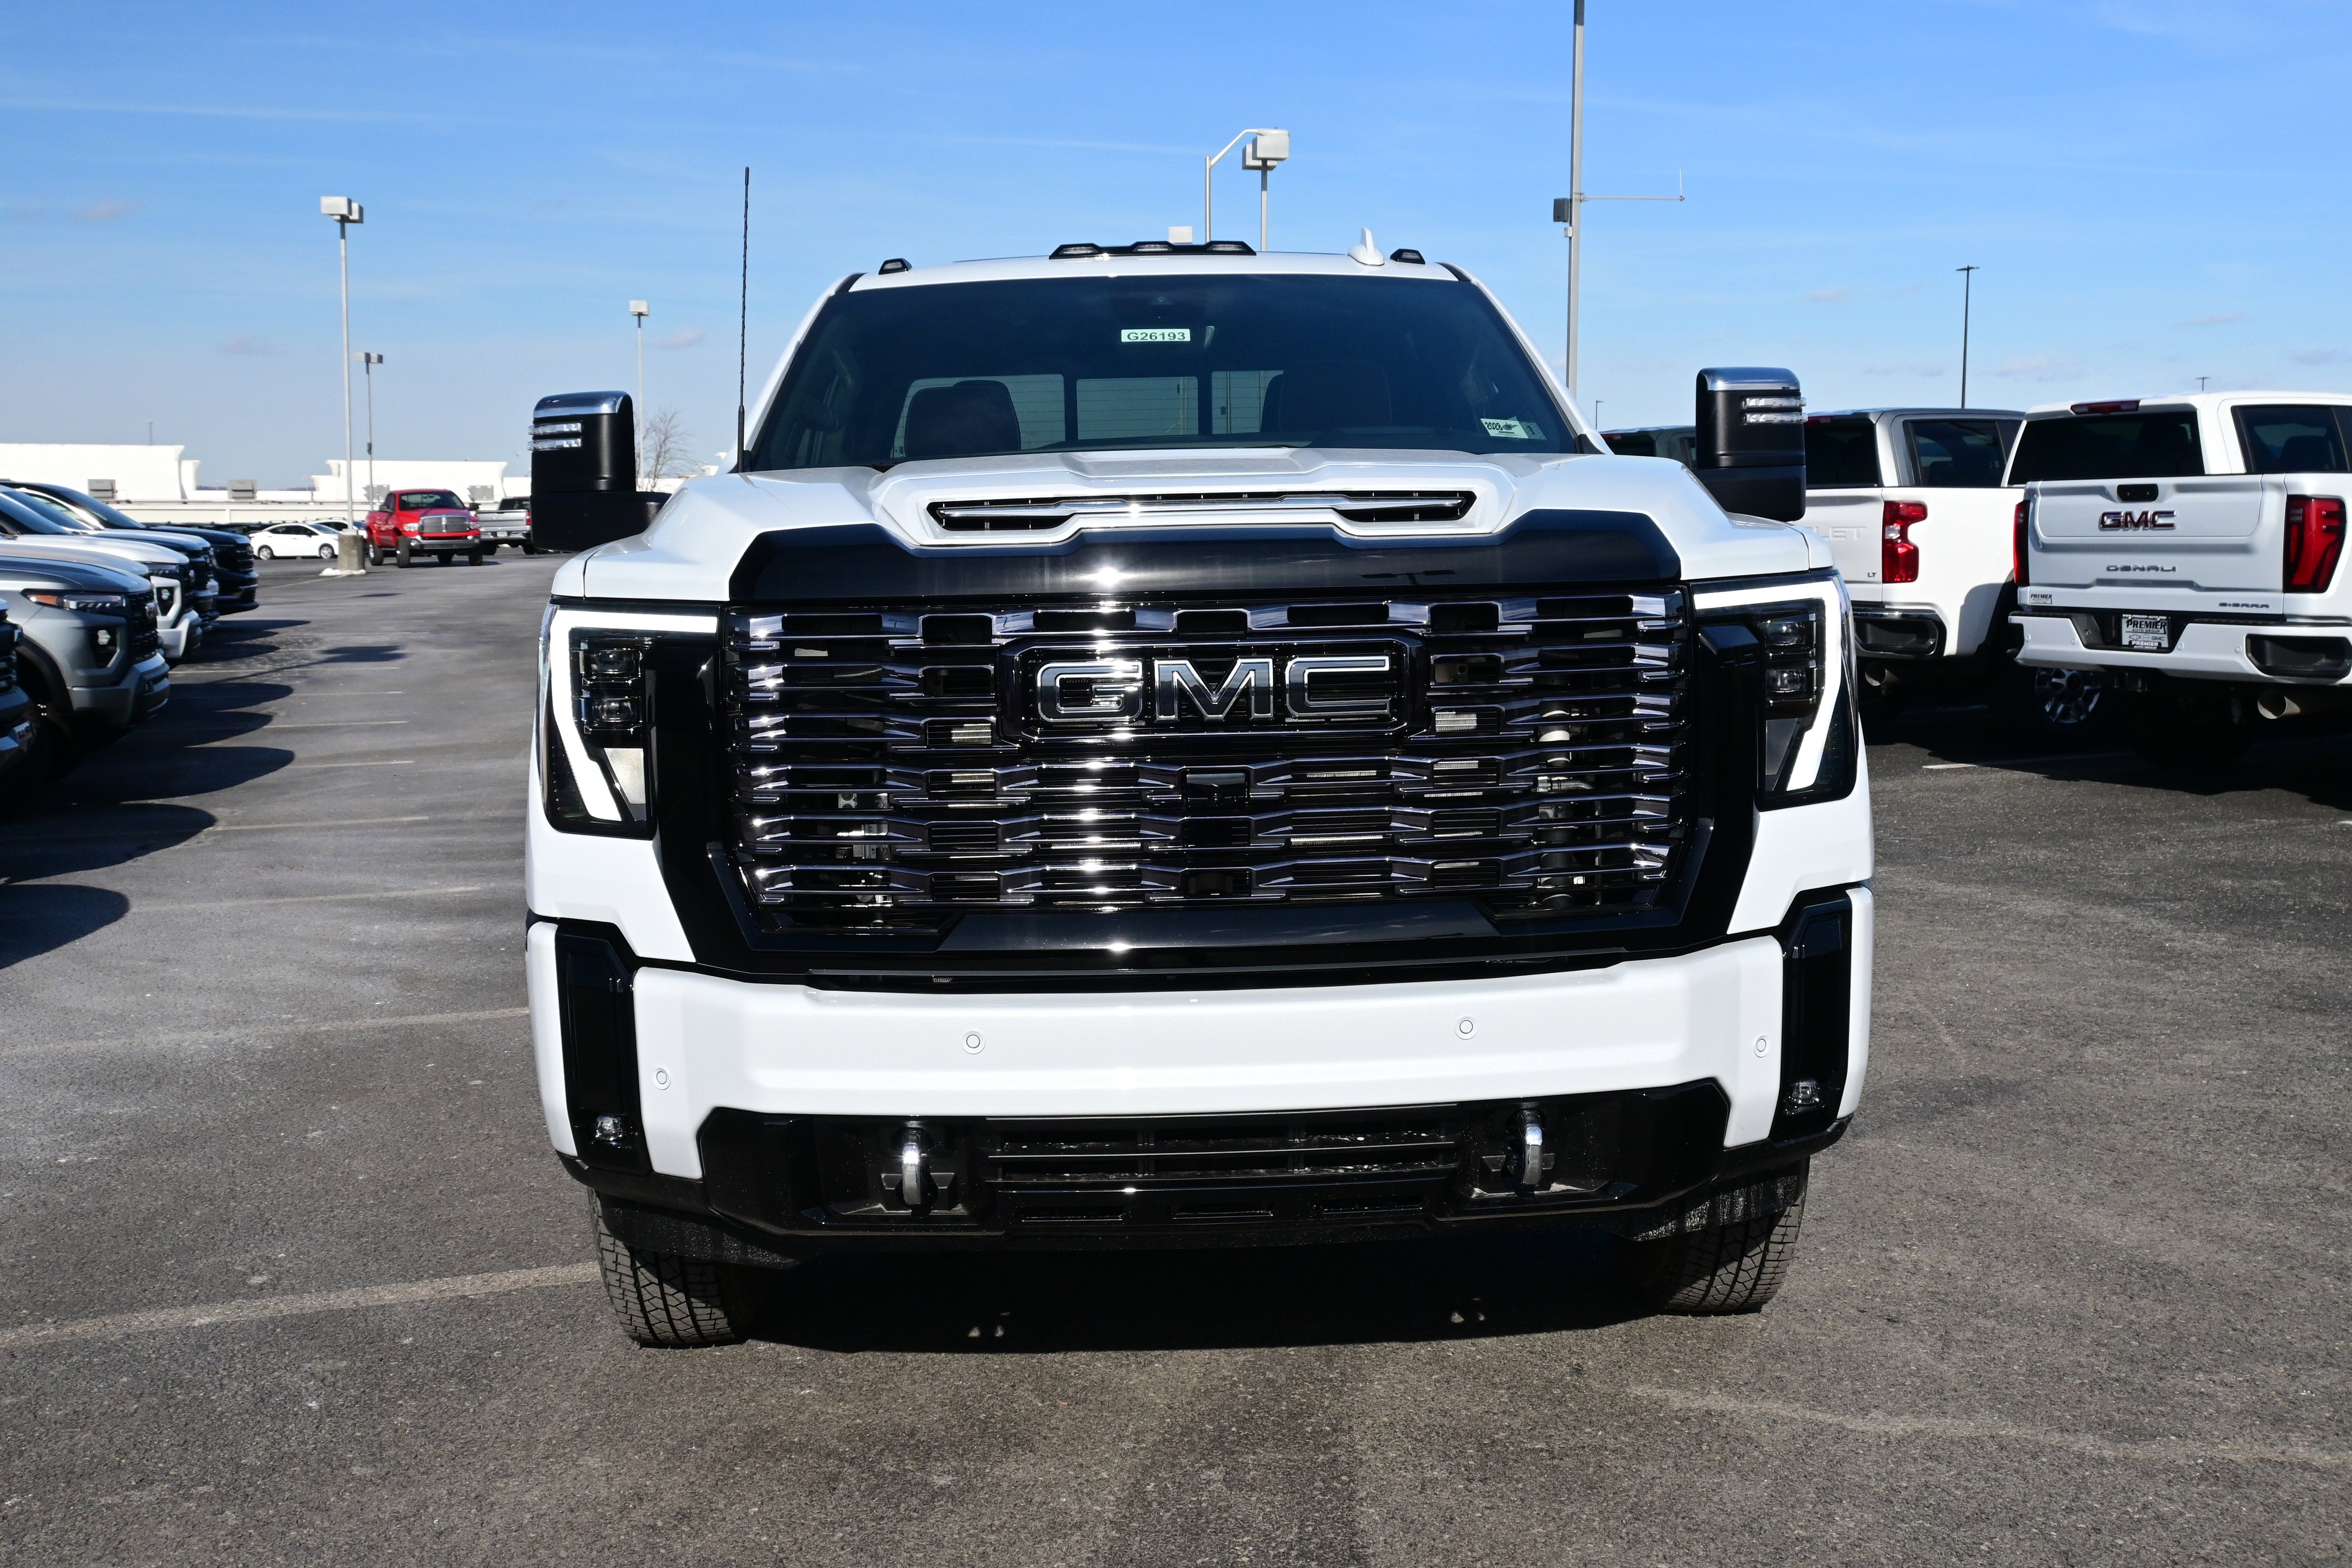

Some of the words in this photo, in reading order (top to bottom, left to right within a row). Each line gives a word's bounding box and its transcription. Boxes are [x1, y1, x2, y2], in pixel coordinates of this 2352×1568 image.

[1127, 332, 1186, 340] G26193
[1485, 422, 1503, 430] 2028
[2099, 510, 2177, 531] GMC
[2126, 619, 2167, 631] PREMIER
[1037, 655, 1391, 724] GMC
